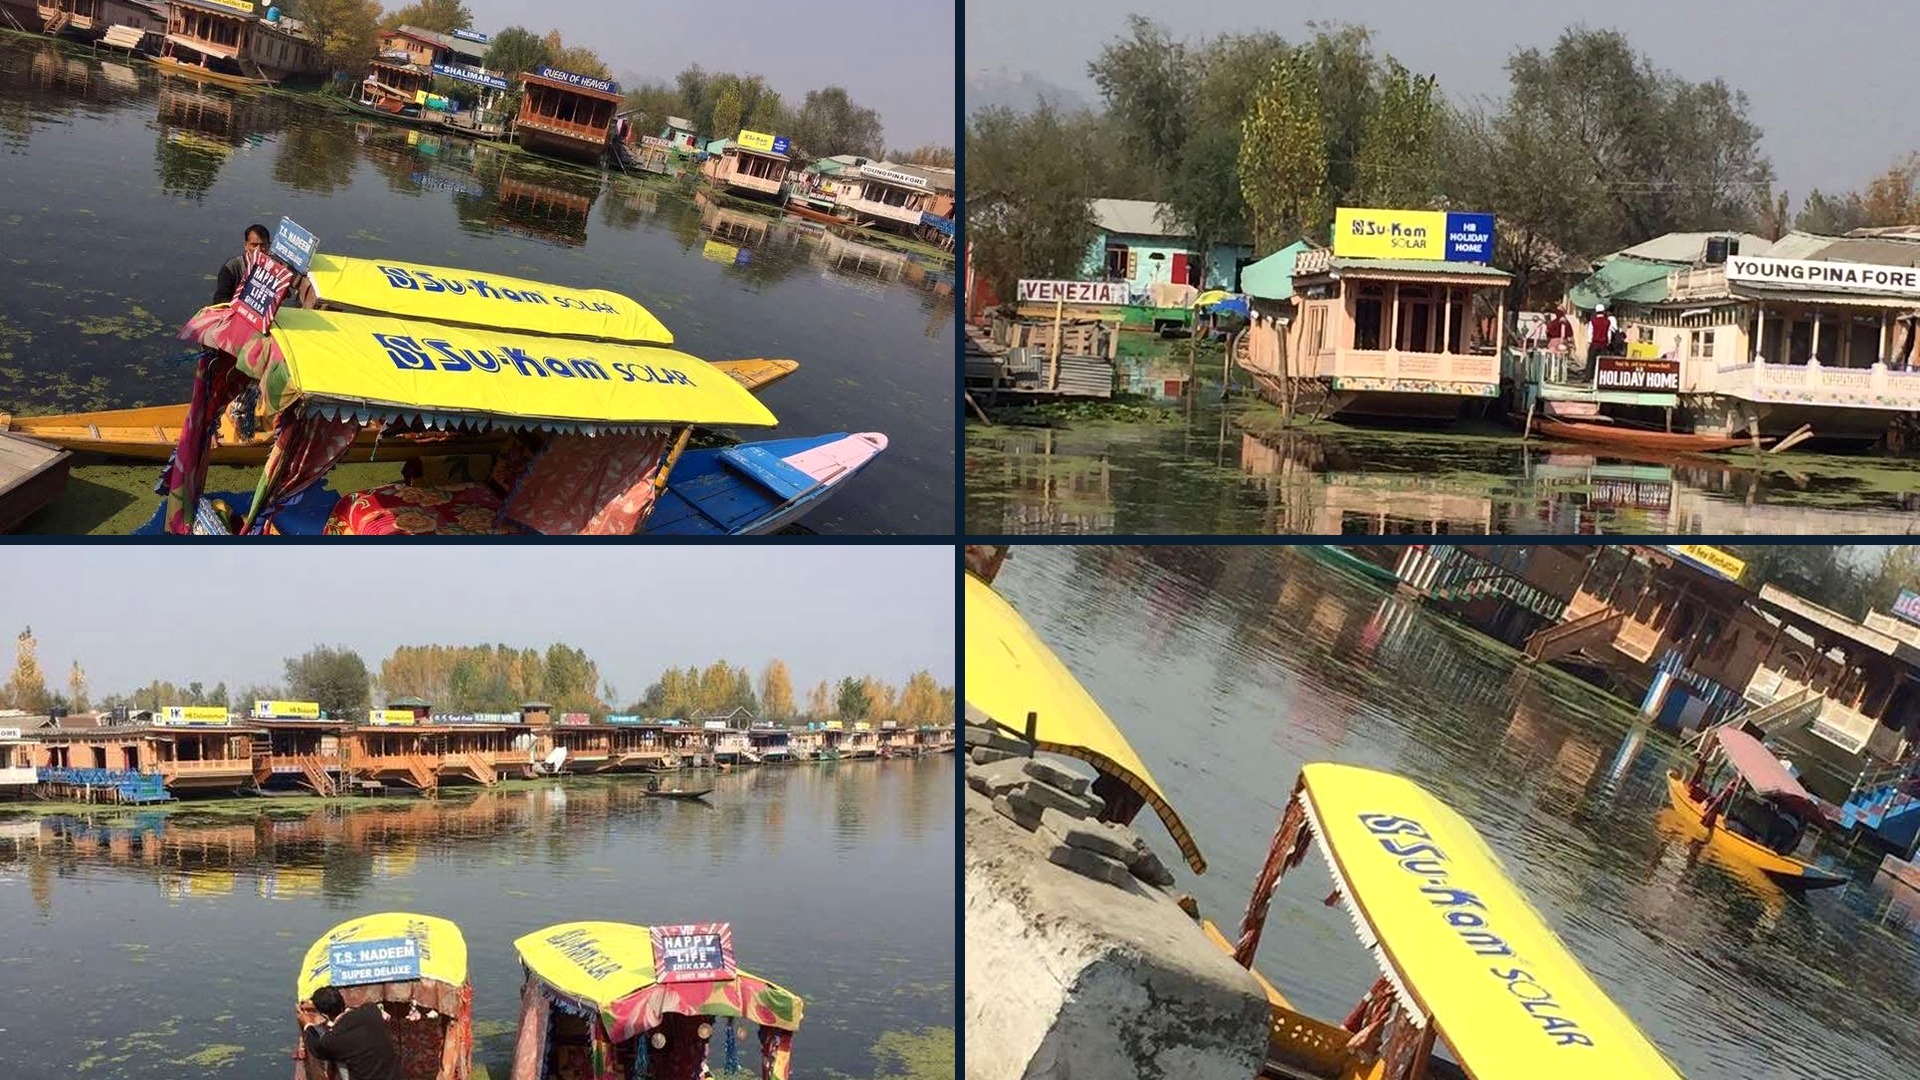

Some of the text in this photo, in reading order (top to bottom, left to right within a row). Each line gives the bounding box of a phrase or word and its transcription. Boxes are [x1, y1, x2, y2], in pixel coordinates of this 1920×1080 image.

[444, 66, 491, 84] SHALIMAR
[490, 79, 507, 87] HOTEL
[543, 68, 610, 91] QUEEN OF HEAVEN
[862, 166, 886, 177] YOUNG
[1365, 221, 1427, 238] Su-Kam
[1450, 233, 1489, 242] HOLIDAY
[288, 231, 311, 254] NADEEM
[1391, 239, 1427, 249] SOLAR
[1455, 243, 1483, 253] HOME
[253, 266, 281, 290] HAPPY
[1734, 261, 1804, 279] YOUNG
[250, 286, 268, 304] LIFE
[412, 270, 549, 305] Su-Kam
[553, 296, 620, 315] SOLAR
[1025, 282, 1111, 302] VENEZIA
[244, 295, 265, 315] SHIKARA
[422, 338, 611, 381] Su-Kam
[613, 362, 697, 388] SOLAR
[1599, 369, 1678, 388] HOLIDAY HOME
[664, 935, 714, 949] HAPPY
[1379, 838, 1516, 955] Su-Kam
[1490, 967, 1594, 1047] SOLAR
[333, 951, 356, 964] T.S.
[360, 945, 415, 962] NADEEM
[677, 951, 707, 963] LIFE
[341, 967, 373, 980] SUPER
[374, 964, 412, 977] DELUXE
[672, 962, 713, 971] SHIKARA
